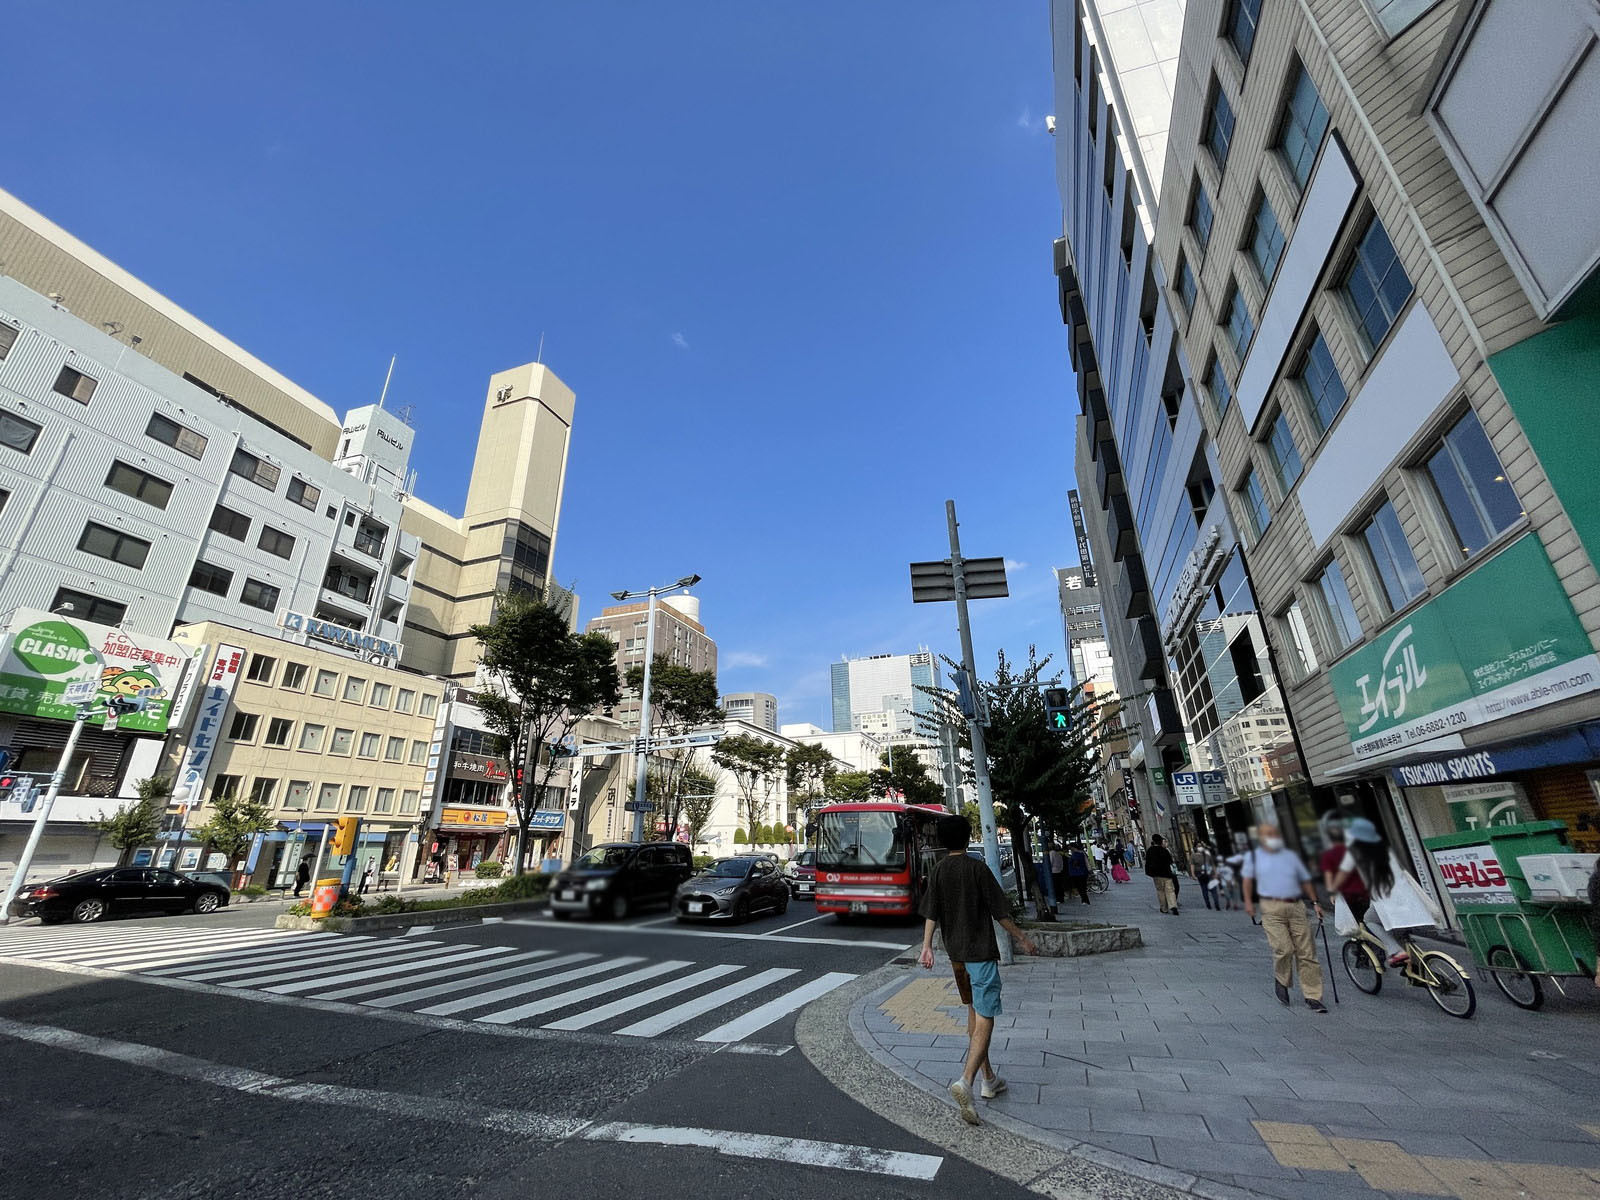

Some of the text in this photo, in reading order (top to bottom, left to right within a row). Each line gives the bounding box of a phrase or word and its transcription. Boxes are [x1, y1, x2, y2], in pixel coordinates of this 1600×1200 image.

[106, 632, 127, 643] FC
[306, 618, 398, 657] KAWAMURA
[101, 641, 181, 668] 加盟店募集中!
[1355, 624, 1427, 733] エイブル
[1178, 774, 1195, 784] JR
[1400, 751, 1496, 786] TSUCHIYA SPORTS
[1440, 860, 1506, 888] ツキムラ
